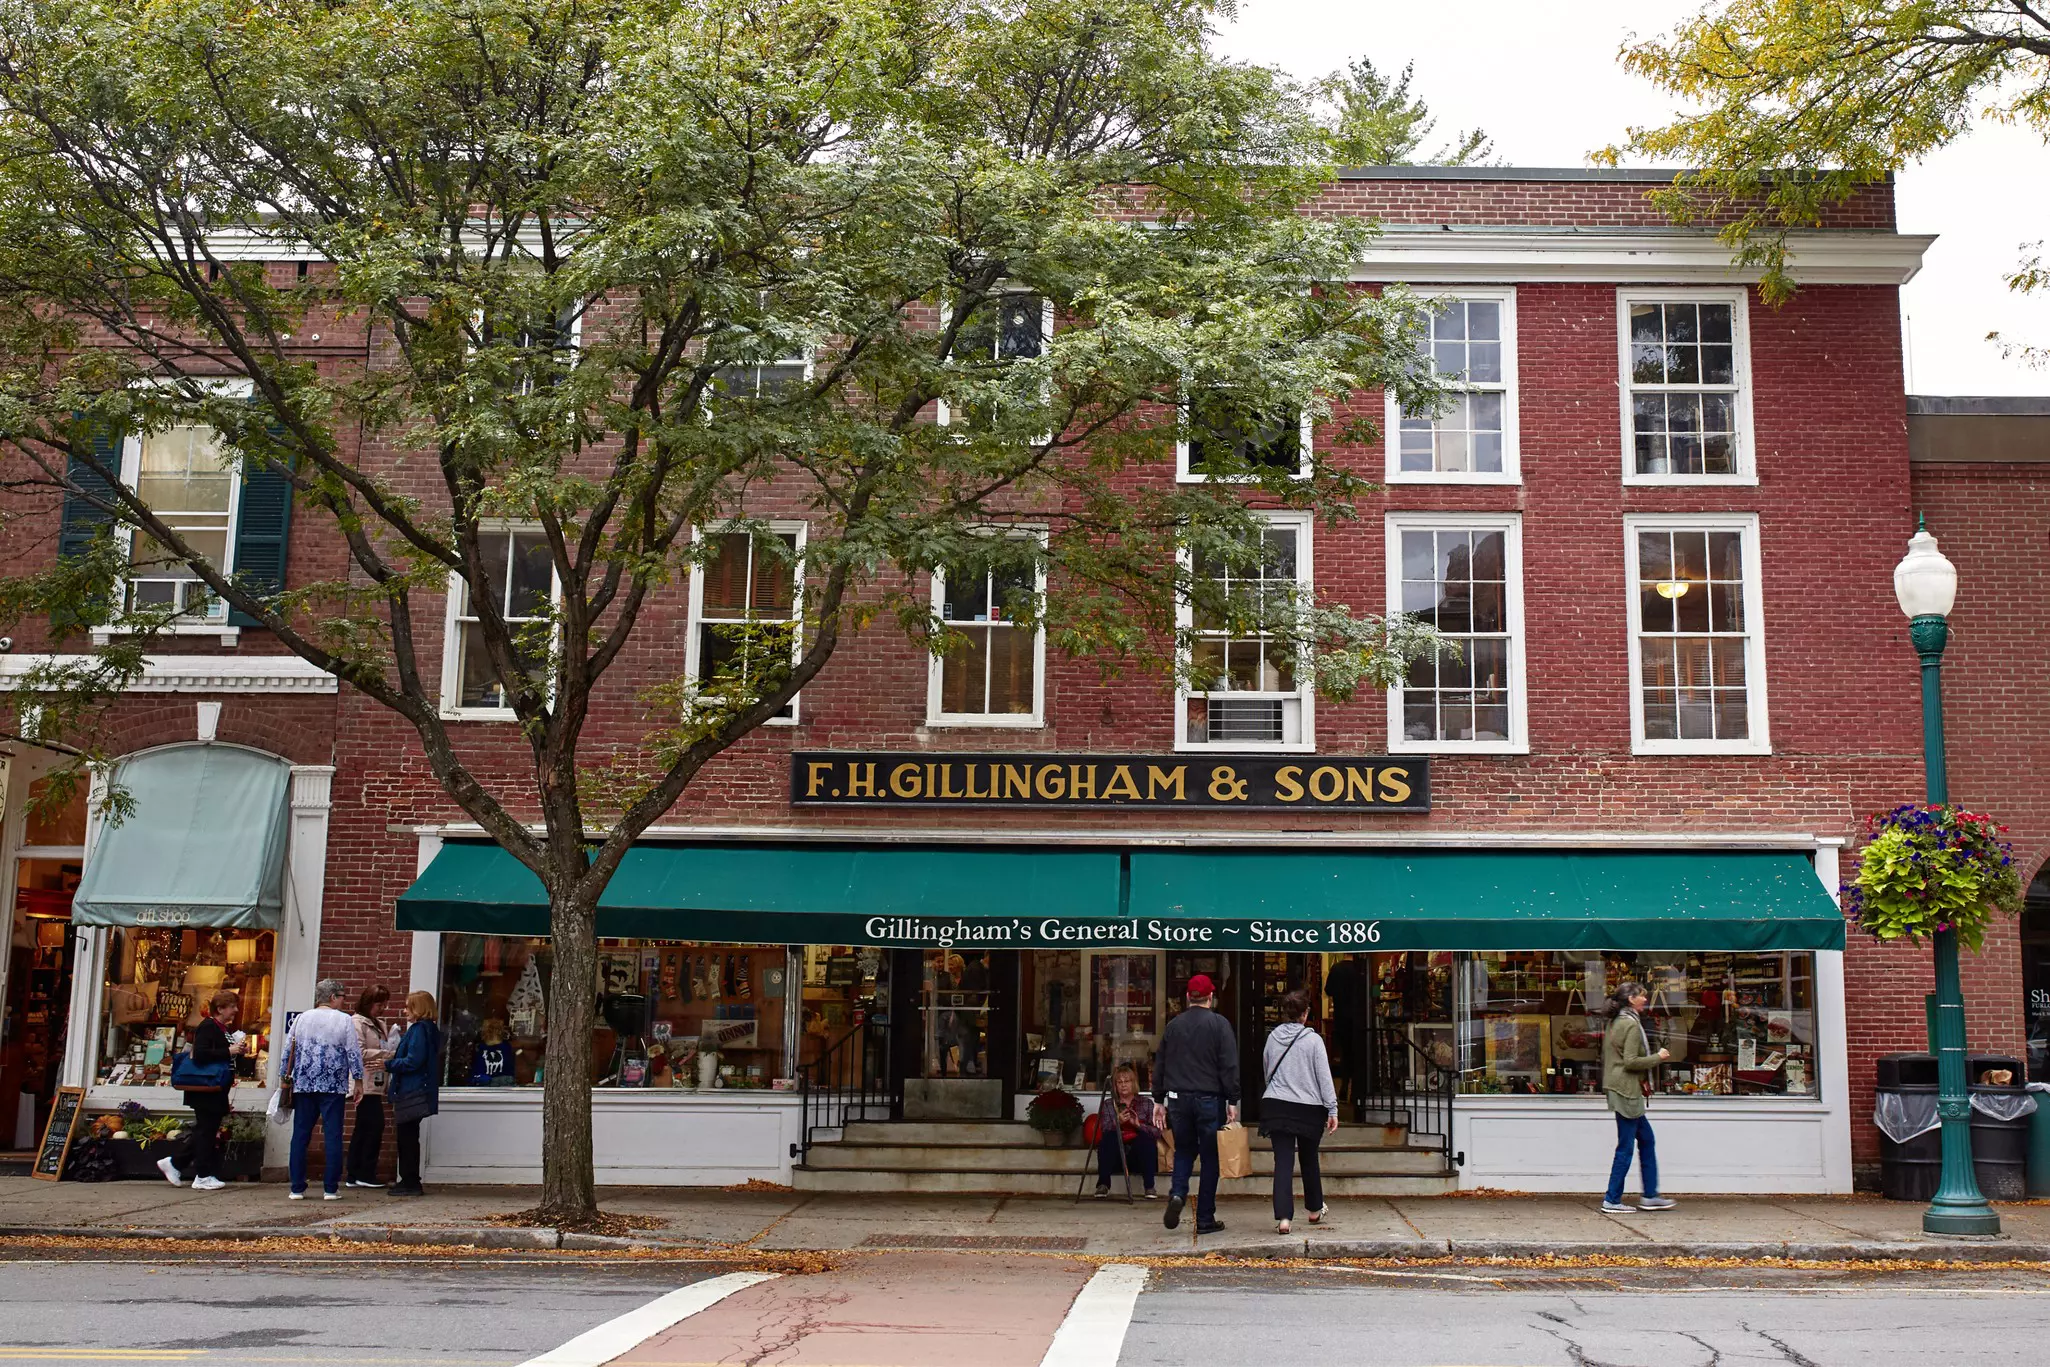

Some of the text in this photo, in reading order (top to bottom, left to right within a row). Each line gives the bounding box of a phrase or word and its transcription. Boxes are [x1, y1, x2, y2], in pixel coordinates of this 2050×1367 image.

[1208, 765, 1248, 801] &
[1274, 765, 1411, 803] SONS
[136, 908, 190, 926] gift shop
[865, 916, 1032, 948] Gillingham's
[1039, 918, 1139, 942] General
[1147, 920, 1213, 942] Store
[1249, 921, 1320, 944] Since
[1326, 921, 1382, 944] 1886
